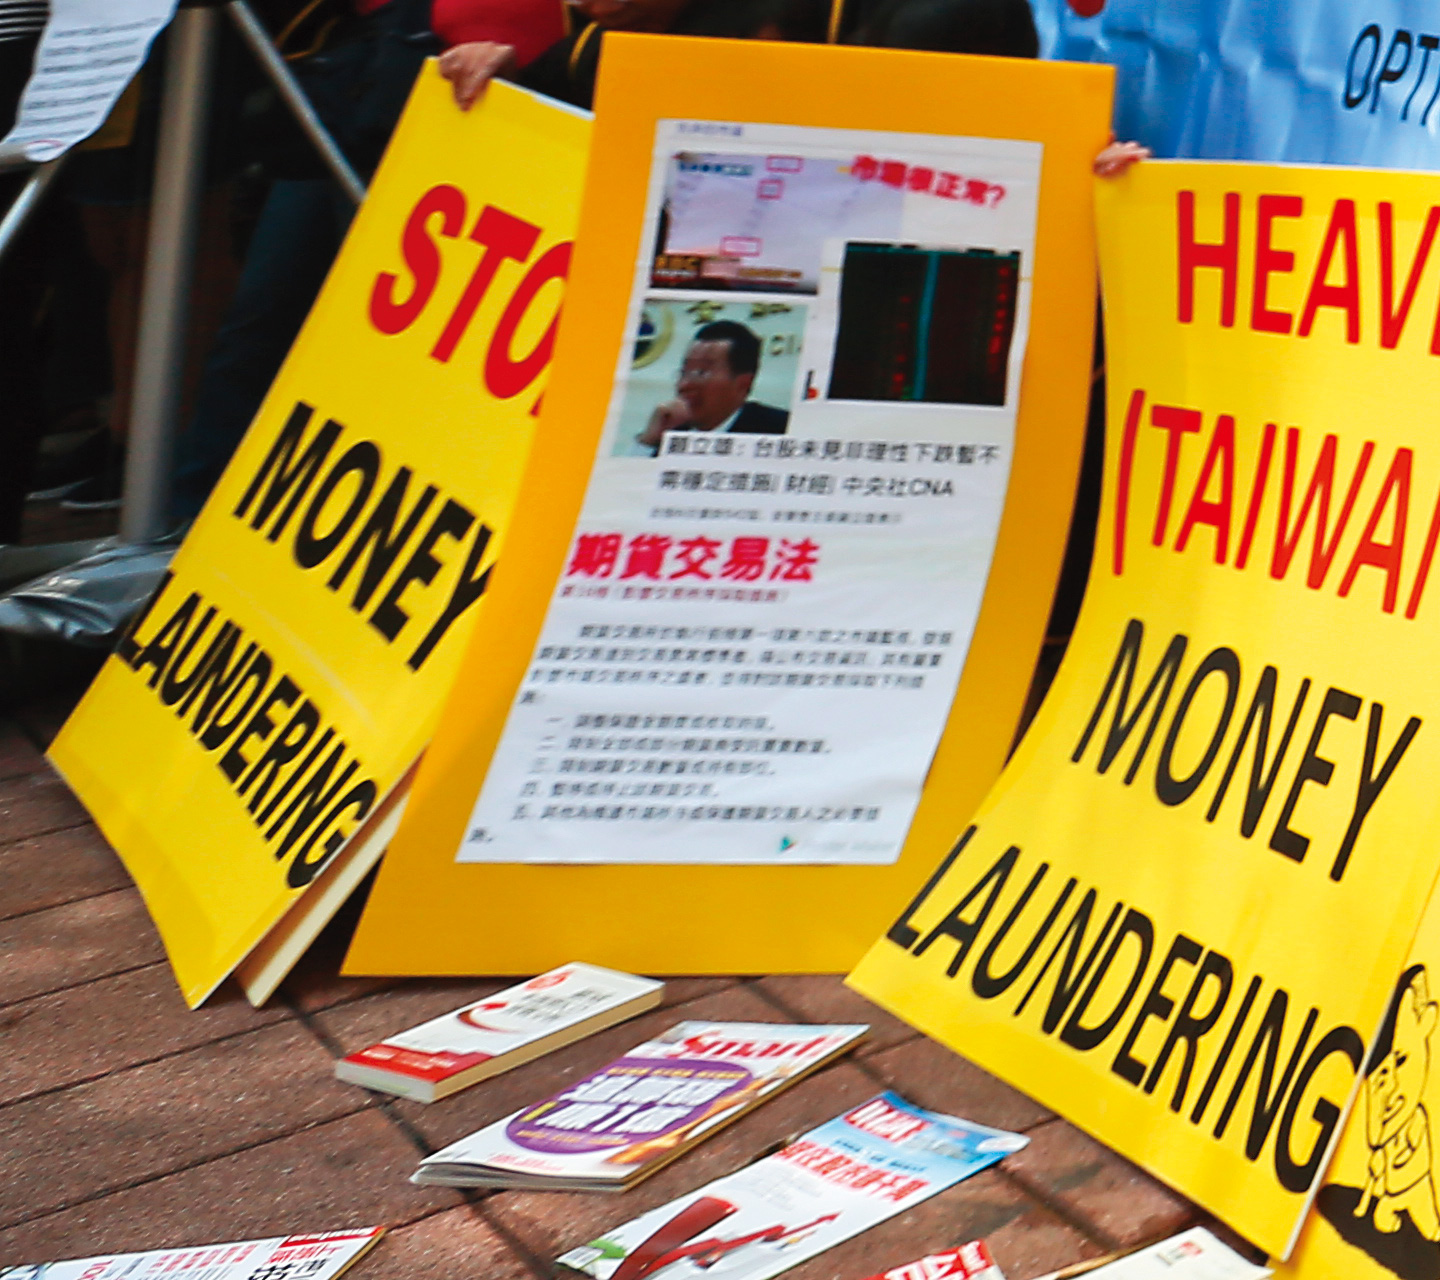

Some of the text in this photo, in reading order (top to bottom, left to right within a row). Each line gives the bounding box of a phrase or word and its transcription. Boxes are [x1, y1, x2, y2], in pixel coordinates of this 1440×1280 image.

[367, 183, 574, 418] STO
[233, 401, 496, 671] MONEY
[566, 532, 821, 584] 期貨交易法
[117, 571, 376, 890] LAUNDERING
[1073, 618, 1423, 882] MONEY
[886, 824, 1368, 1195] LAUNDERING
